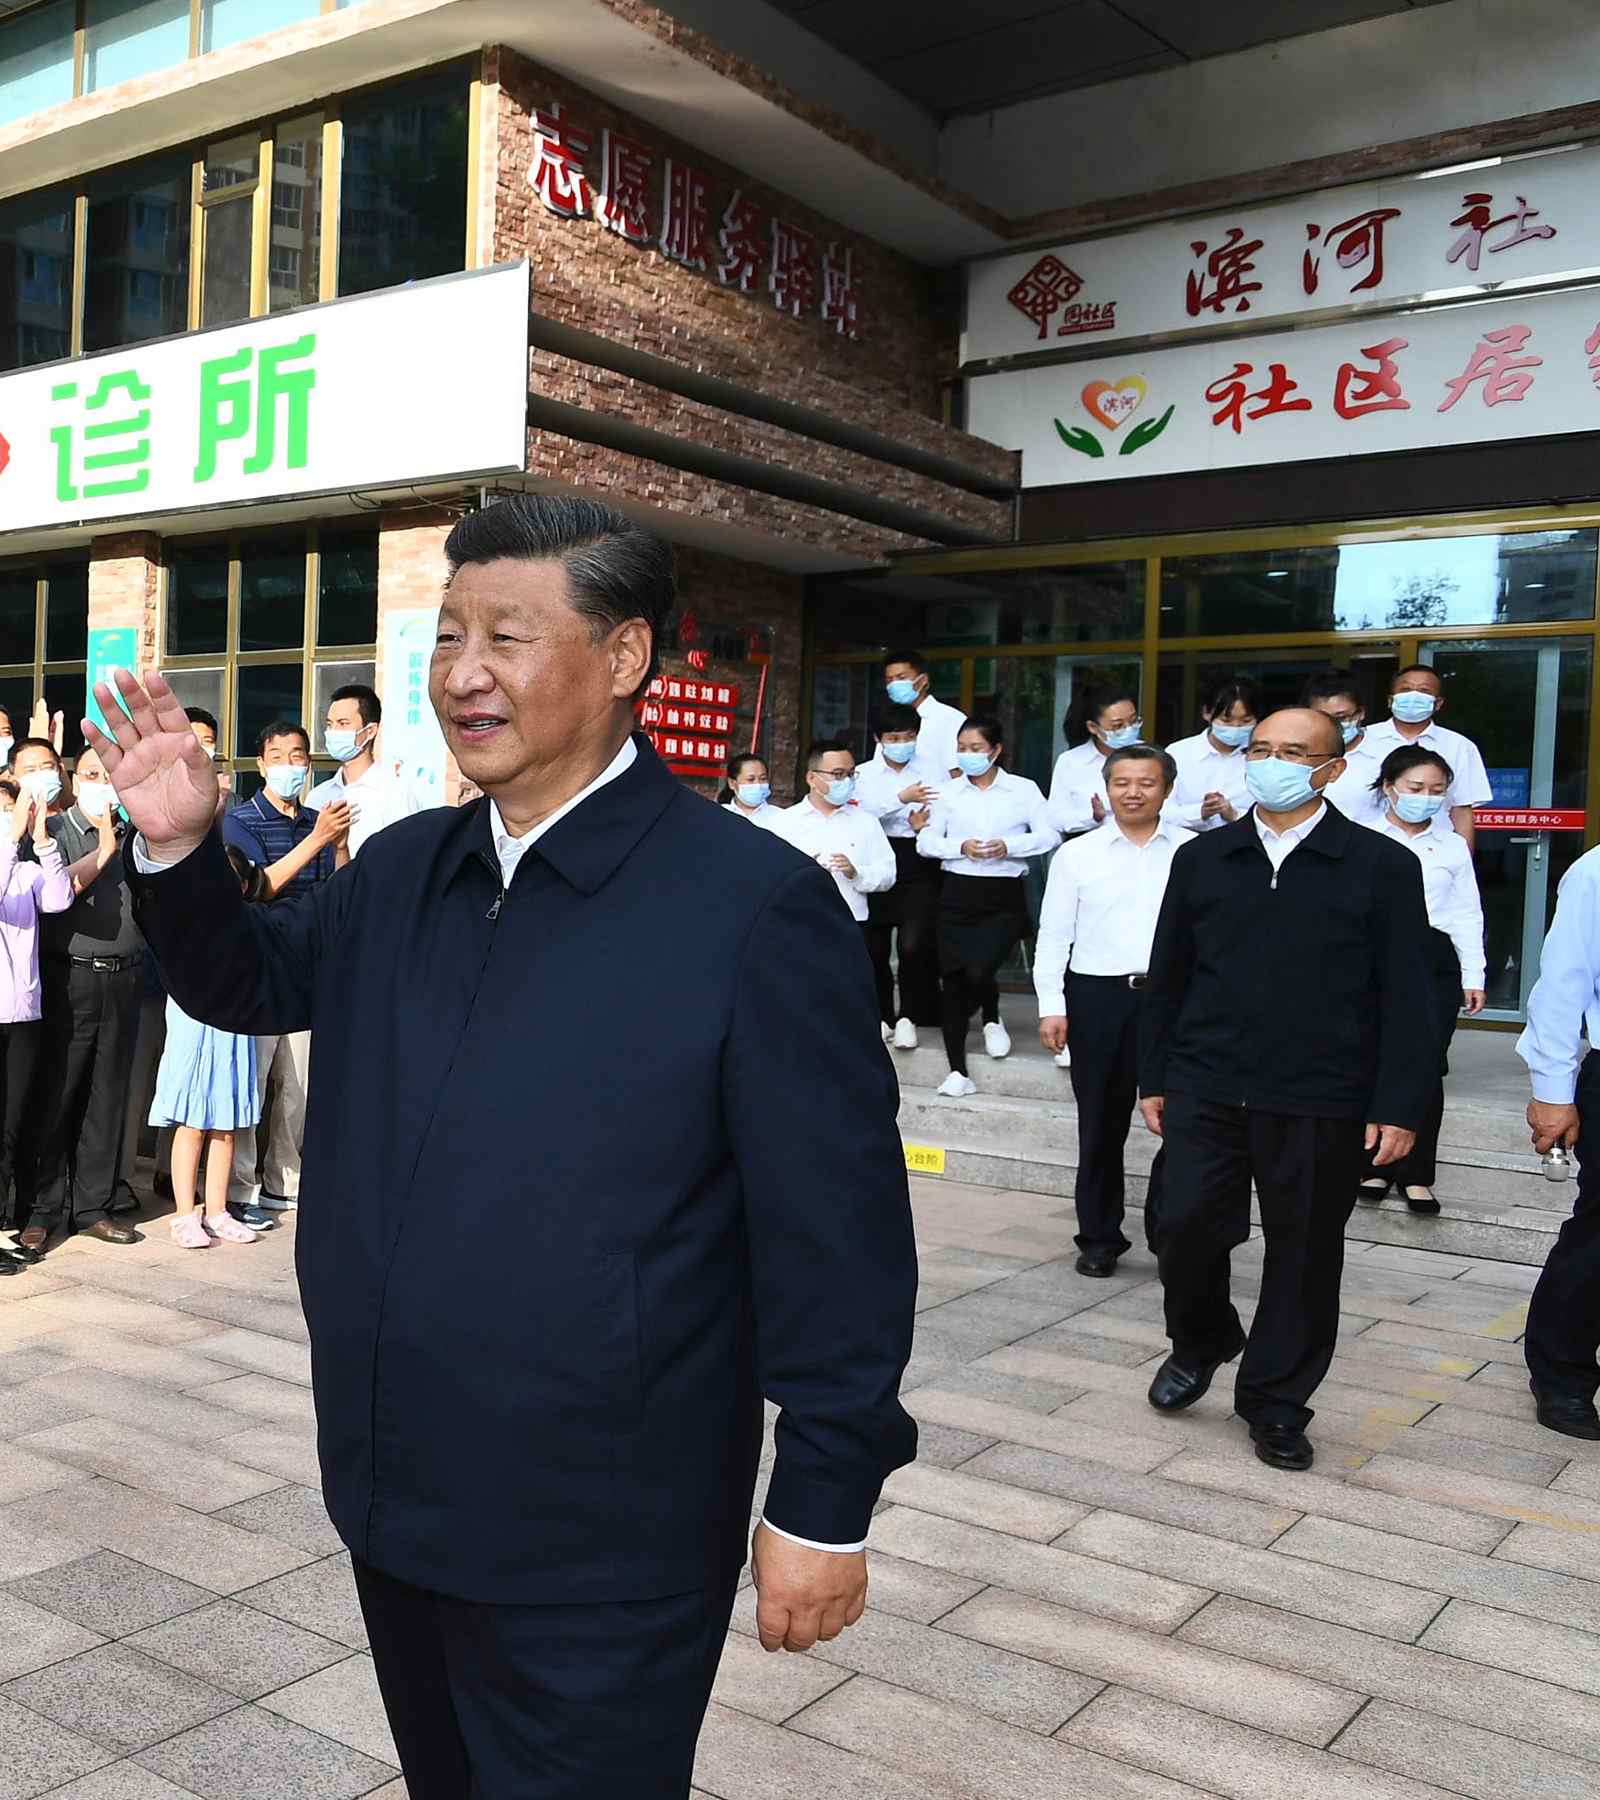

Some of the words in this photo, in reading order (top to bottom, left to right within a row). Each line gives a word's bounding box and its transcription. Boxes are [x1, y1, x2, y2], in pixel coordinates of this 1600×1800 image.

[528, 102, 862, 340] 志愿服务驿站
[1185, 193, 1557, 316] 滨河社
[1205, 322, 1600, 434] 社区居
